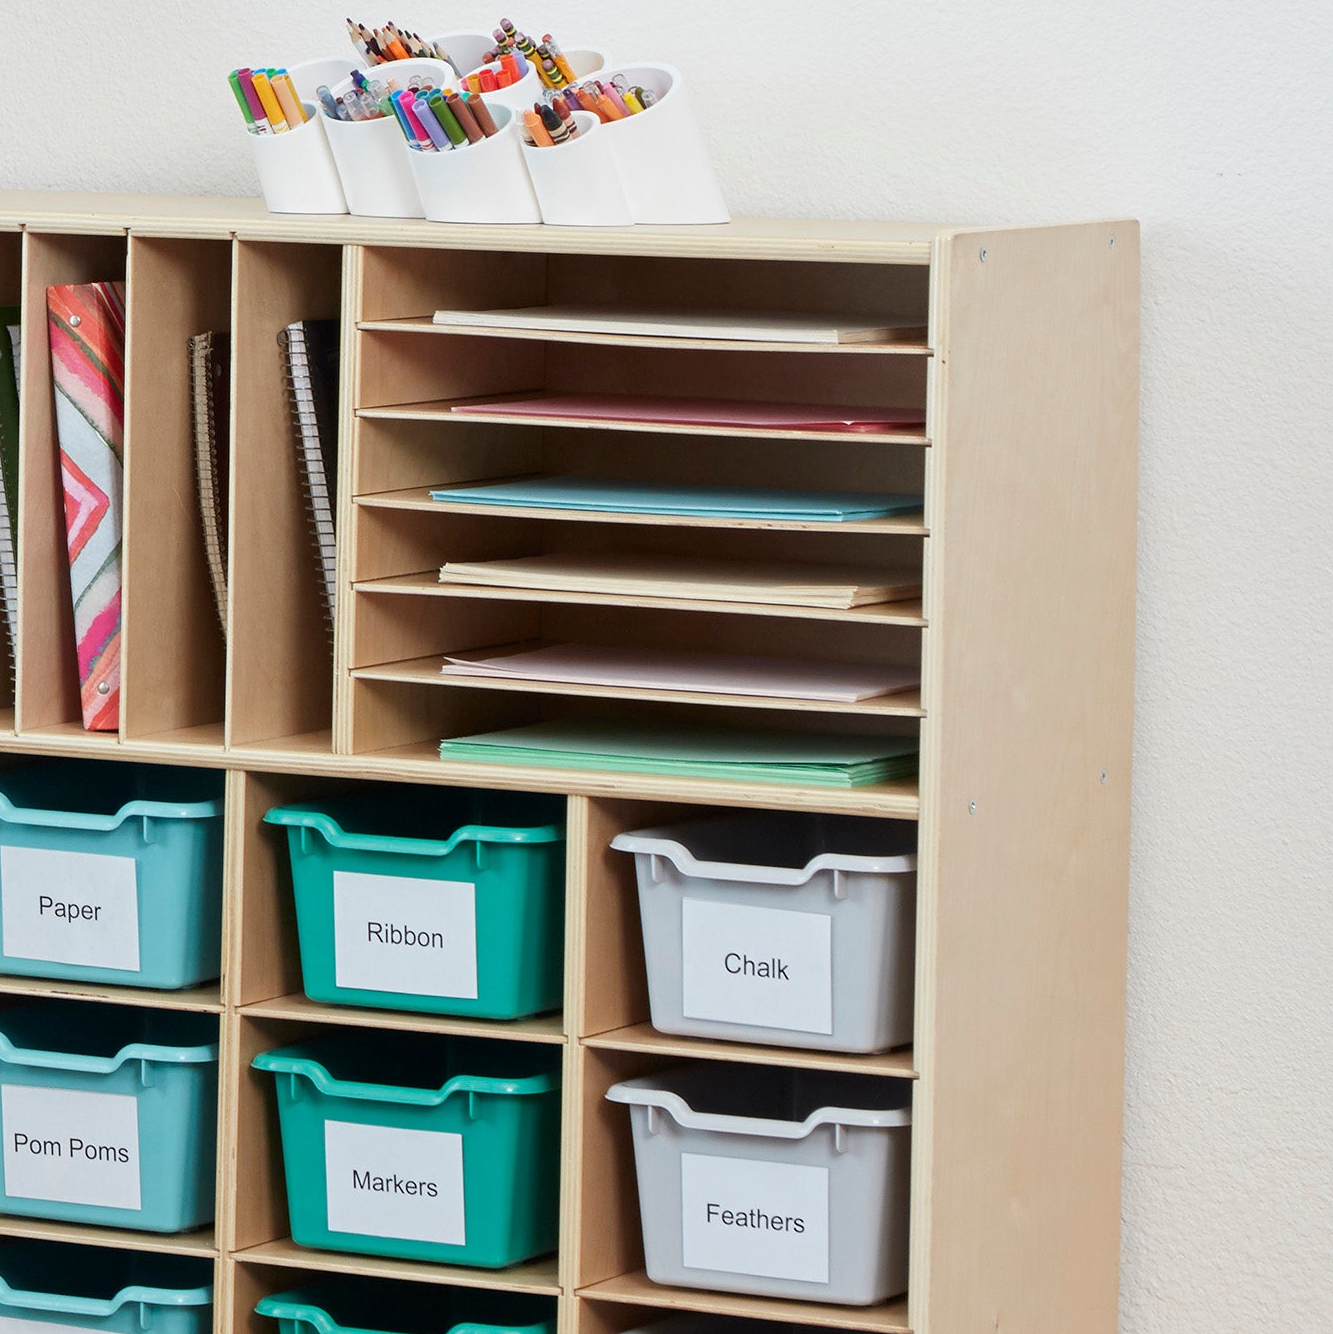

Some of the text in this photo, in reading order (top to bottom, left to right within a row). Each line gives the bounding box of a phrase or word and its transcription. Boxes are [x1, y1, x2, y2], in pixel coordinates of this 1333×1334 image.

[40, 896, 101, 923] Paper
[368, 922, 443, 948] Ribbon
[725, 953, 789, 980] Chalk
[15, 1133, 129, 1162] Pom Poms
[353, 1170, 437, 1197] Markers
[707, 1204, 804, 1233] Feathers
